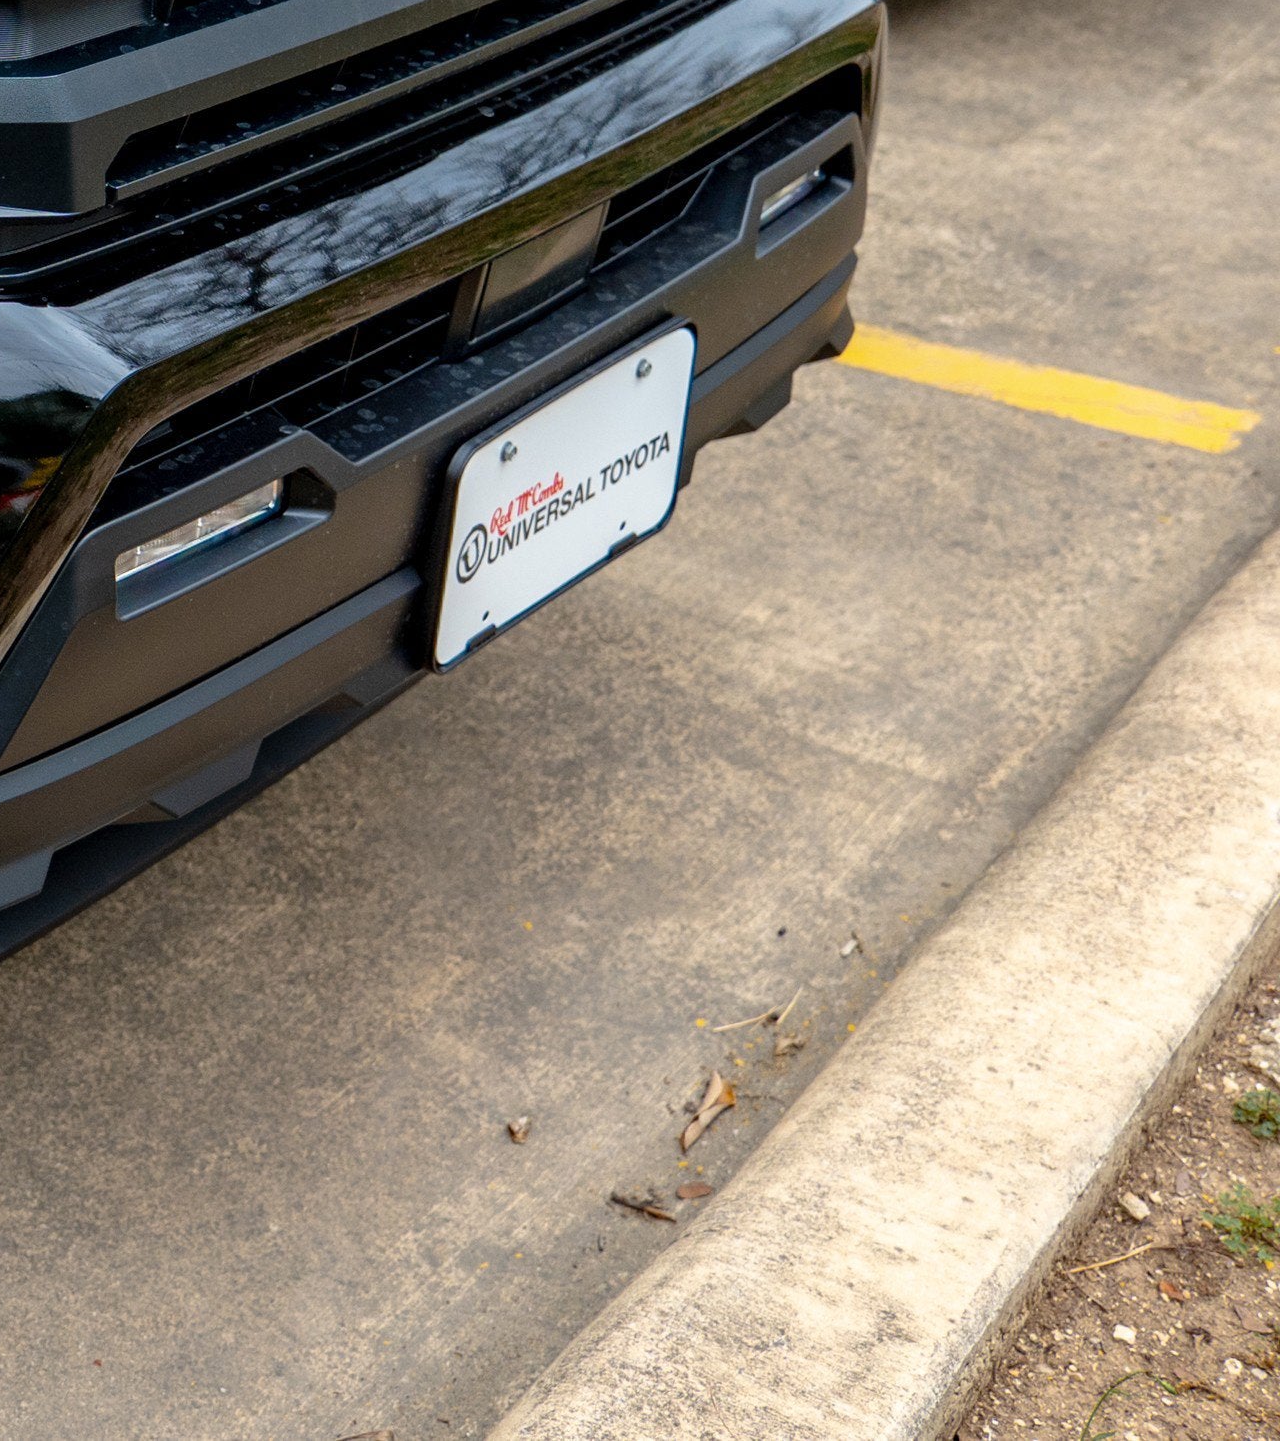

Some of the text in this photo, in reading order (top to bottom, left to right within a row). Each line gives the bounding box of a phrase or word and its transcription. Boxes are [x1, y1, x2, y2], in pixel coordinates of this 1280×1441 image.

[487, 430, 670, 564] UNIVERSAL TOYOTA
[490, 501, 514, 536] Red
